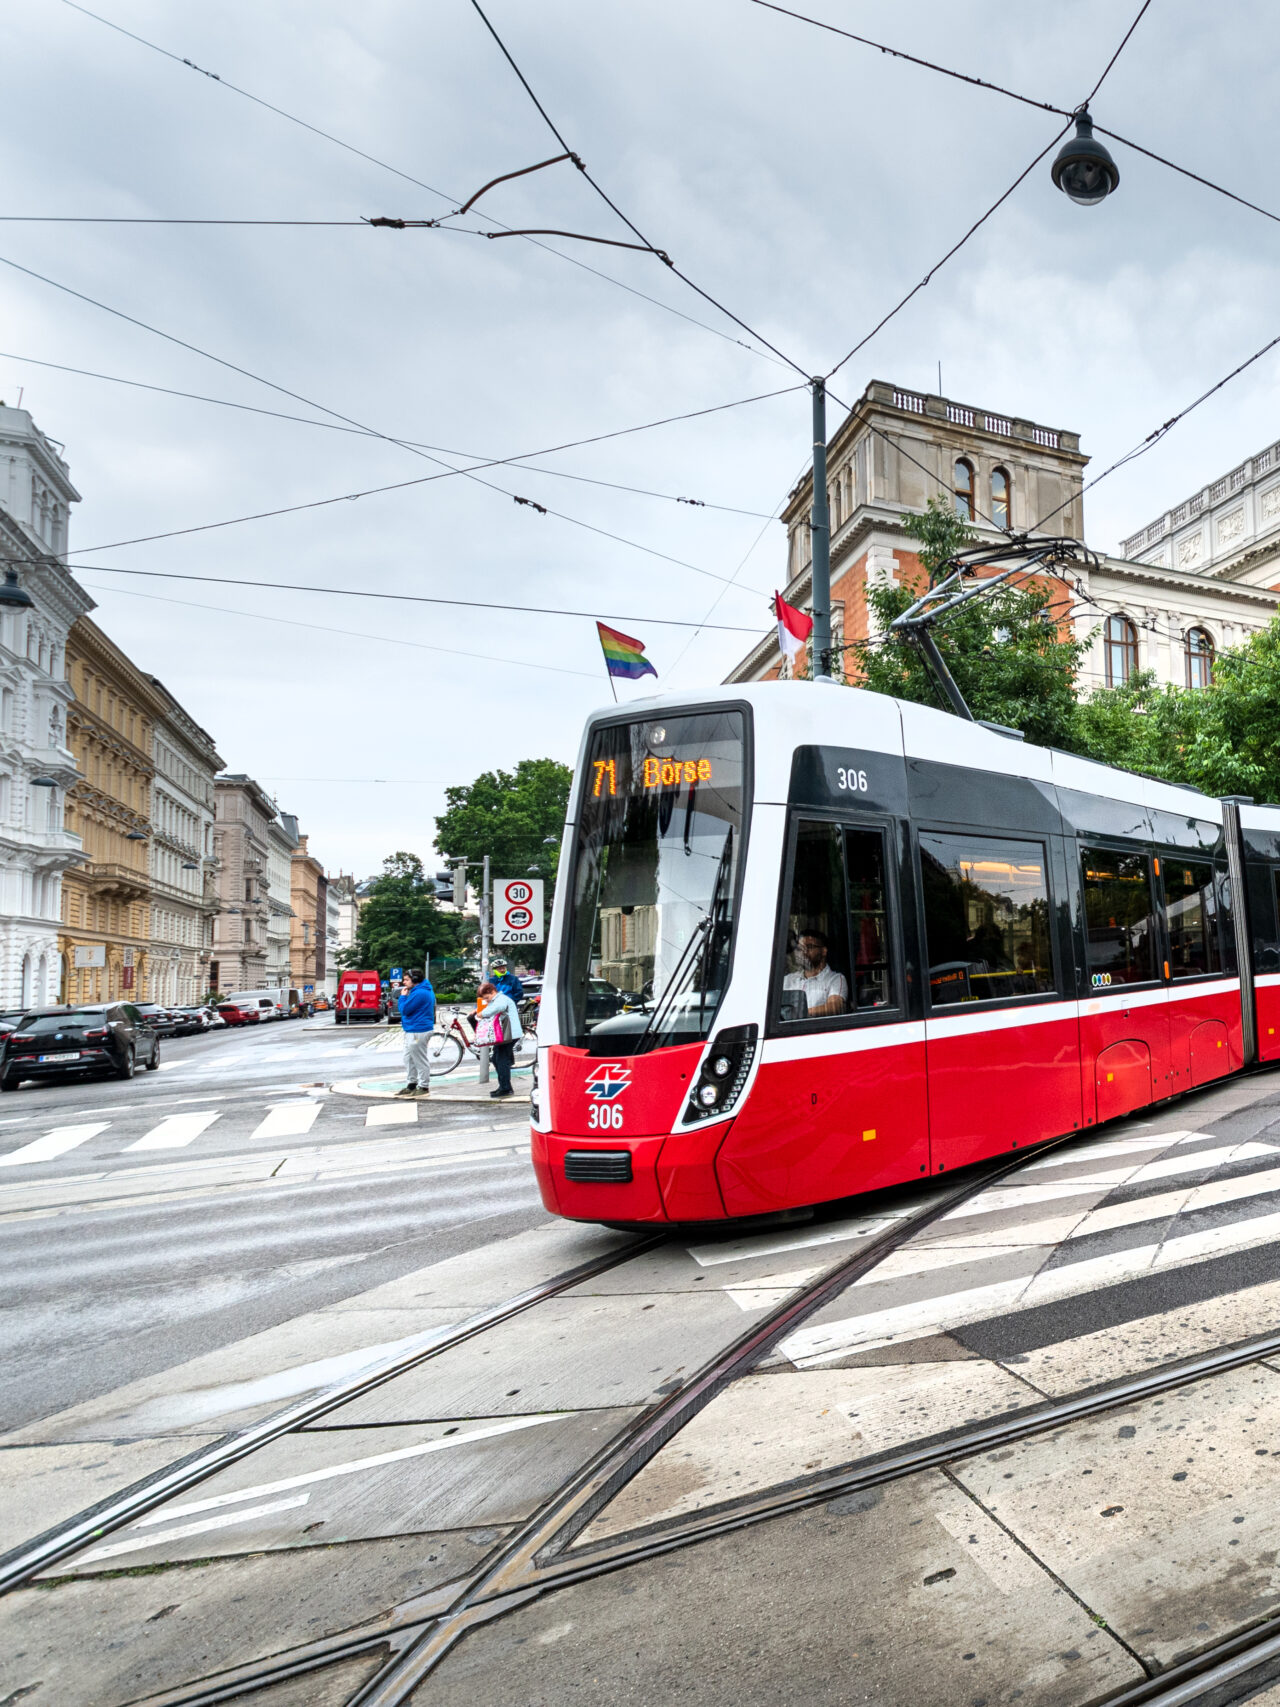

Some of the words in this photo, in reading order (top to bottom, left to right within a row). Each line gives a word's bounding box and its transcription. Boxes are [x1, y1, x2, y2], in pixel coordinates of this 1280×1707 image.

[593, 759, 616, 797] 71
[643, 758, 712, 788] Börse
[837, 767, 868, 792] 306
[512, 887, 526, 899] 30
[501, 930, 537, 942] Zone
[588, 1103, 623, 1129] 306
